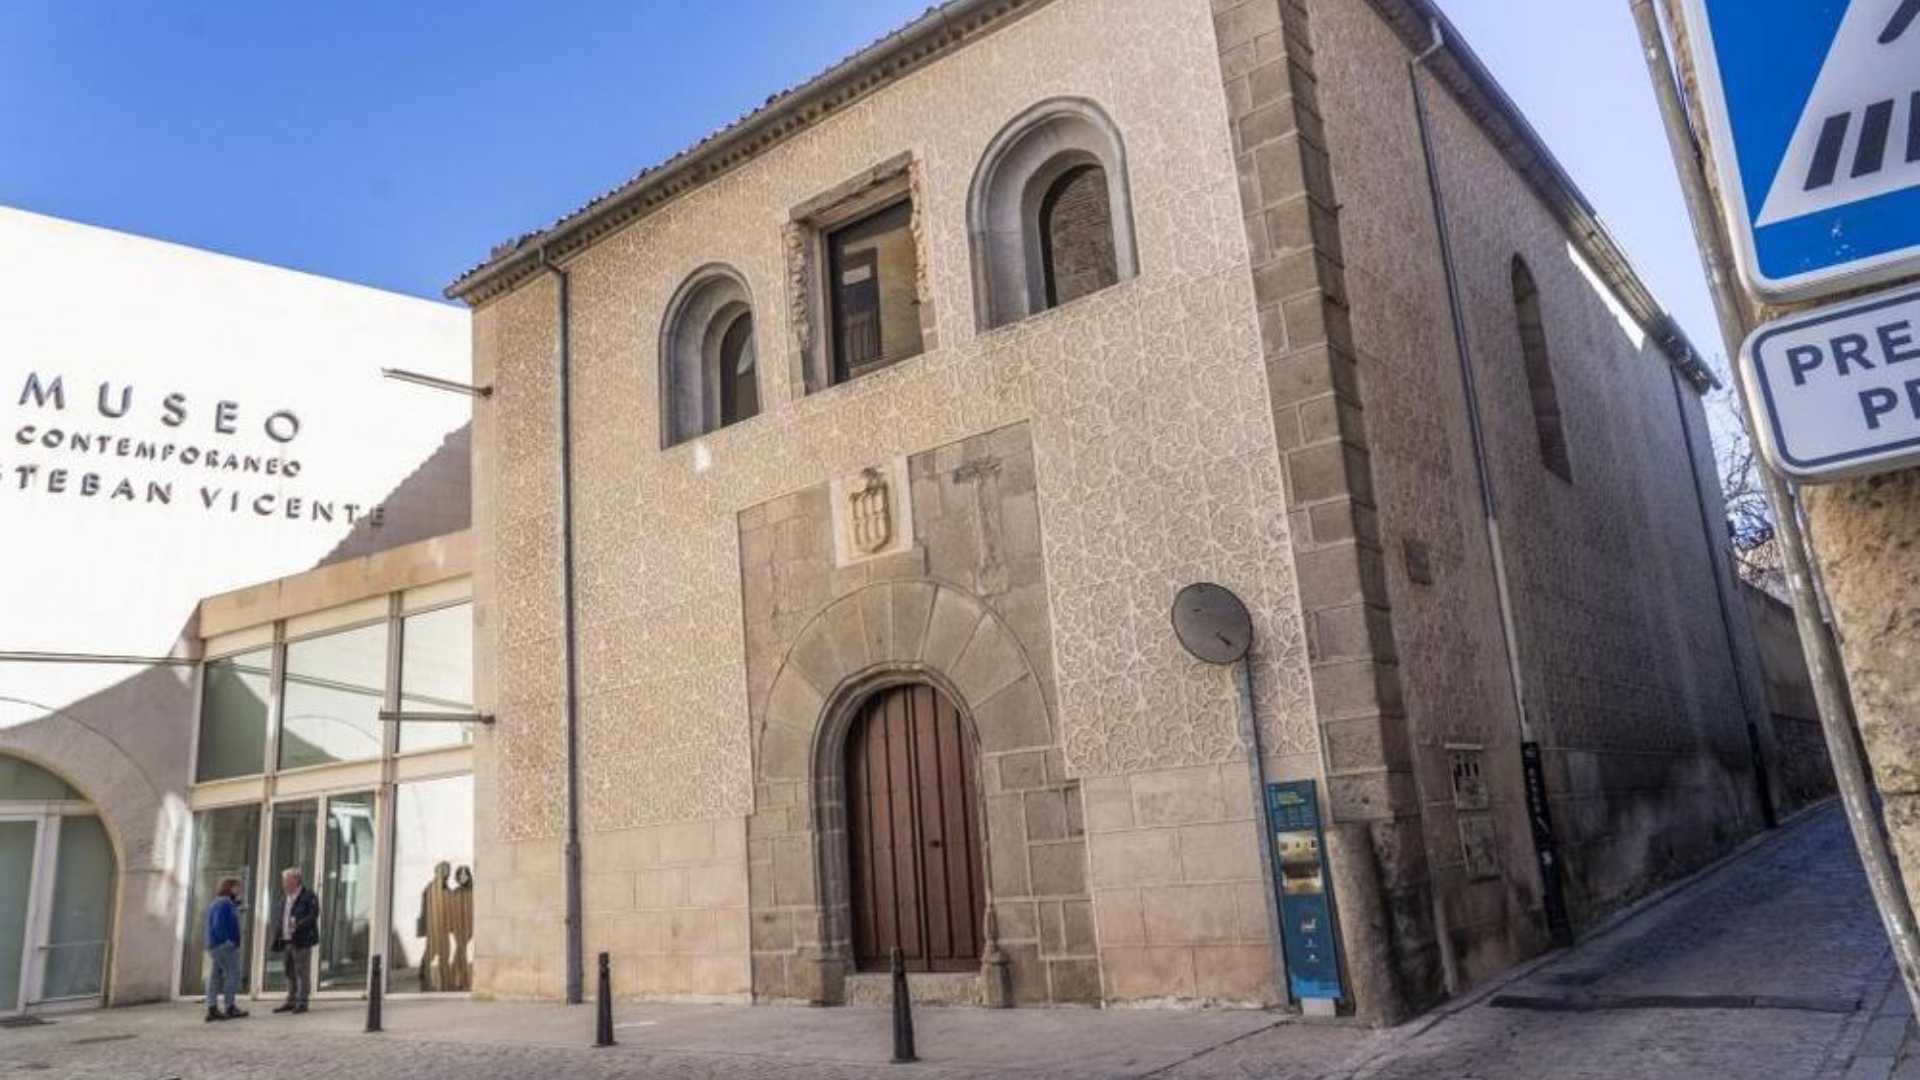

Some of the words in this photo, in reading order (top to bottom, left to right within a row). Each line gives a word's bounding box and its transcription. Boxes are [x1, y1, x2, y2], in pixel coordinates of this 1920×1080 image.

[1786, 319, 1920, 387] PRE
[17, 371, 301, 443] MUSEO
[15, 424, 301, 478] CONTEMPORANEO
[0, 462, 172, 505] TEBAN
[199, 486, 386, 528] VICENTE
